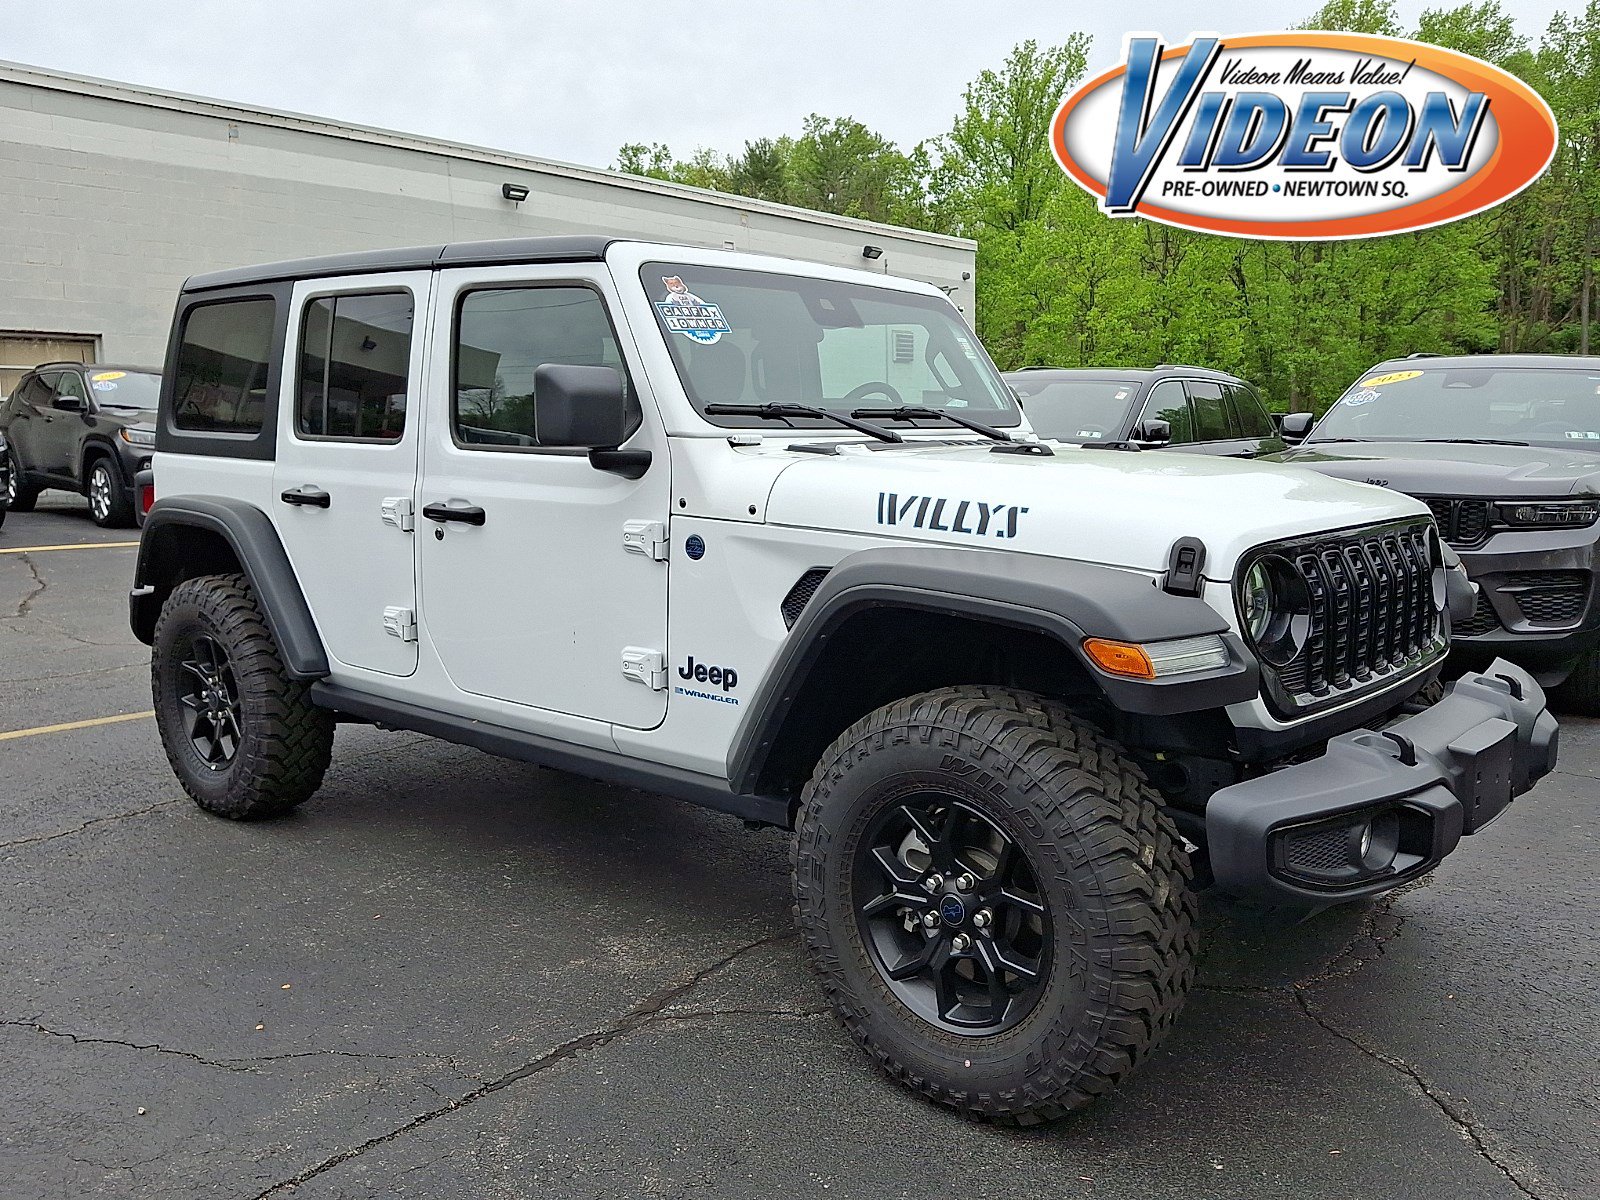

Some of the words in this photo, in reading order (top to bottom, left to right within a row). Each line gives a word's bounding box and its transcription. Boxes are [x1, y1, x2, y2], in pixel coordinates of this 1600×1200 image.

[663, 307, 719, 318] CARFAX
[679, 319, 725, 330] OWNER
[877, 492, 1030, 538] WILLYS
[678, 655, 738, 692] Jeep
[684, 688, 739, 706] WRANGLER
